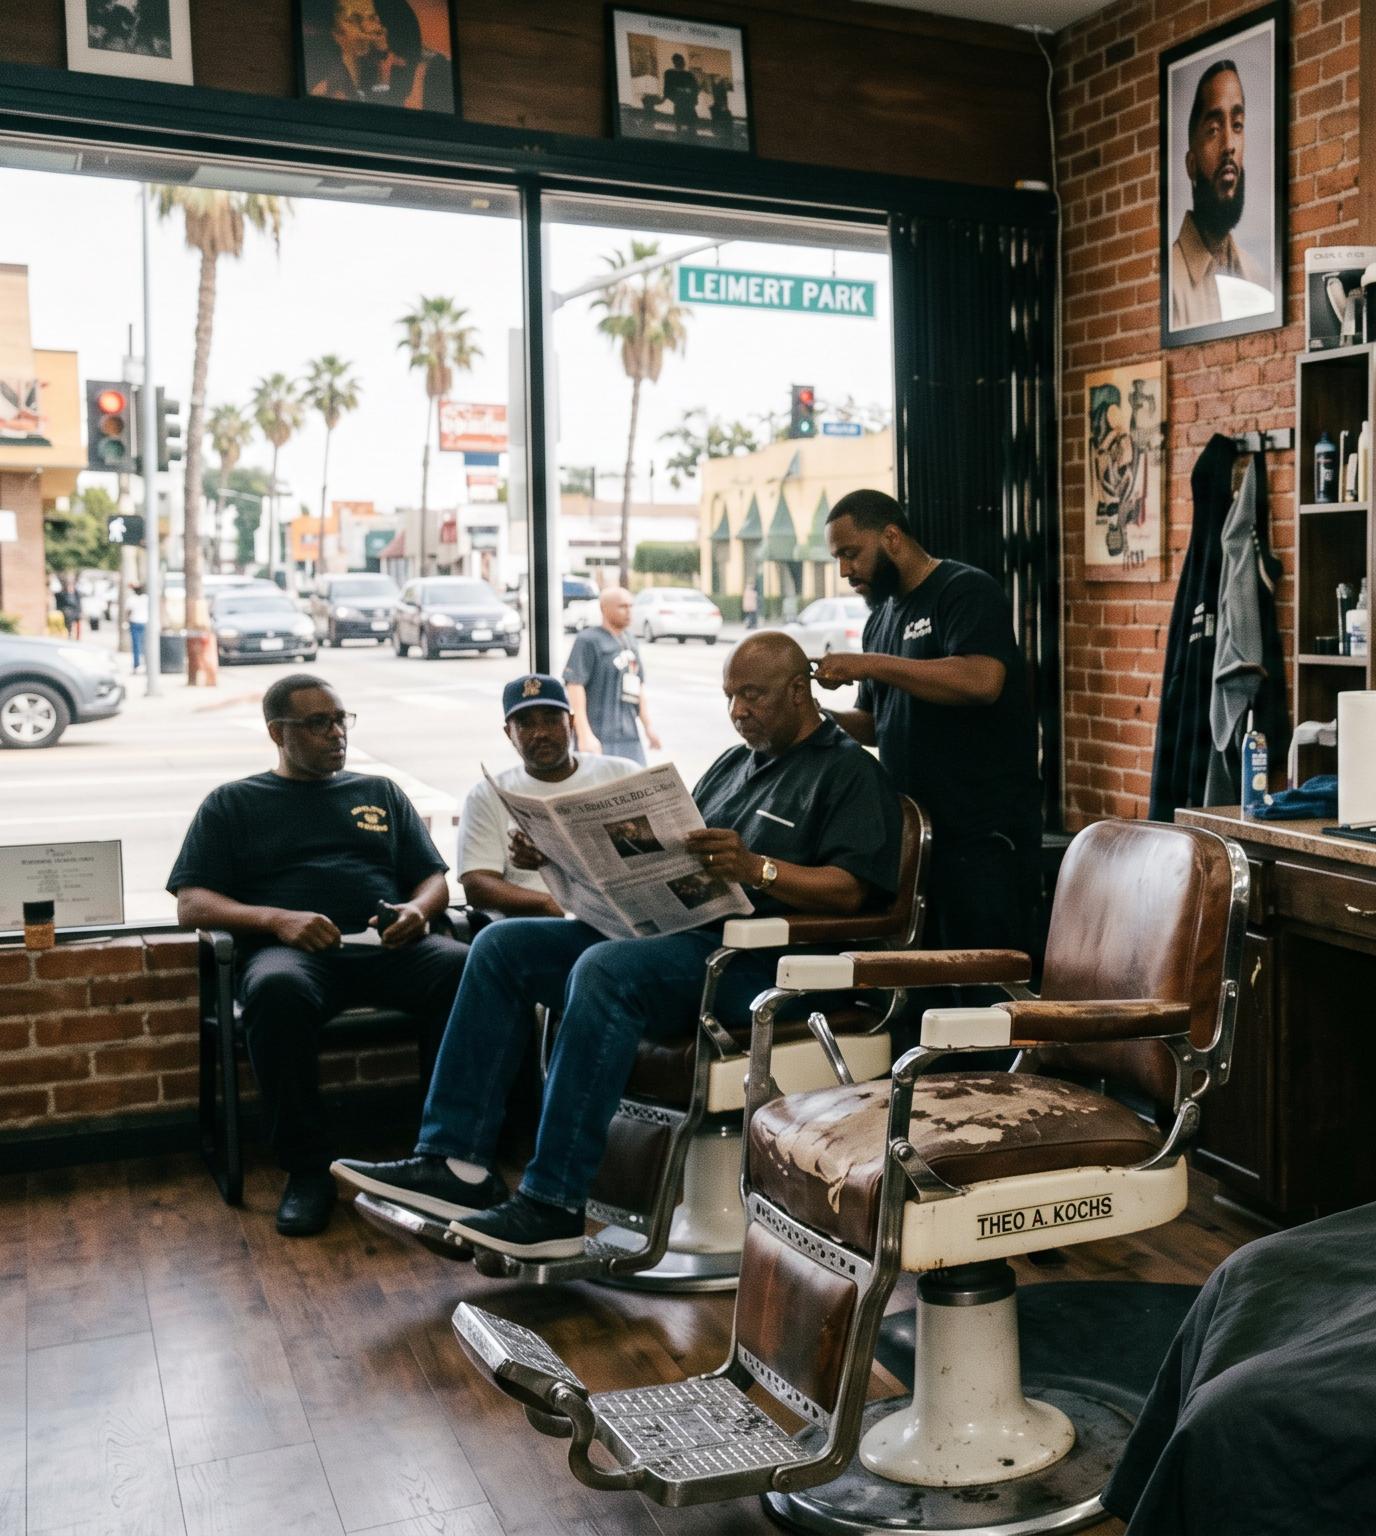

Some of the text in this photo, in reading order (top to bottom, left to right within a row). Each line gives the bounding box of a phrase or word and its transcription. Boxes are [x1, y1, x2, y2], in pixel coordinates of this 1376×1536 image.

[687, 271, 867, 313] LEIMERT PARK
[977, 1196, 1112, 1236] THEO A. KOCHS
